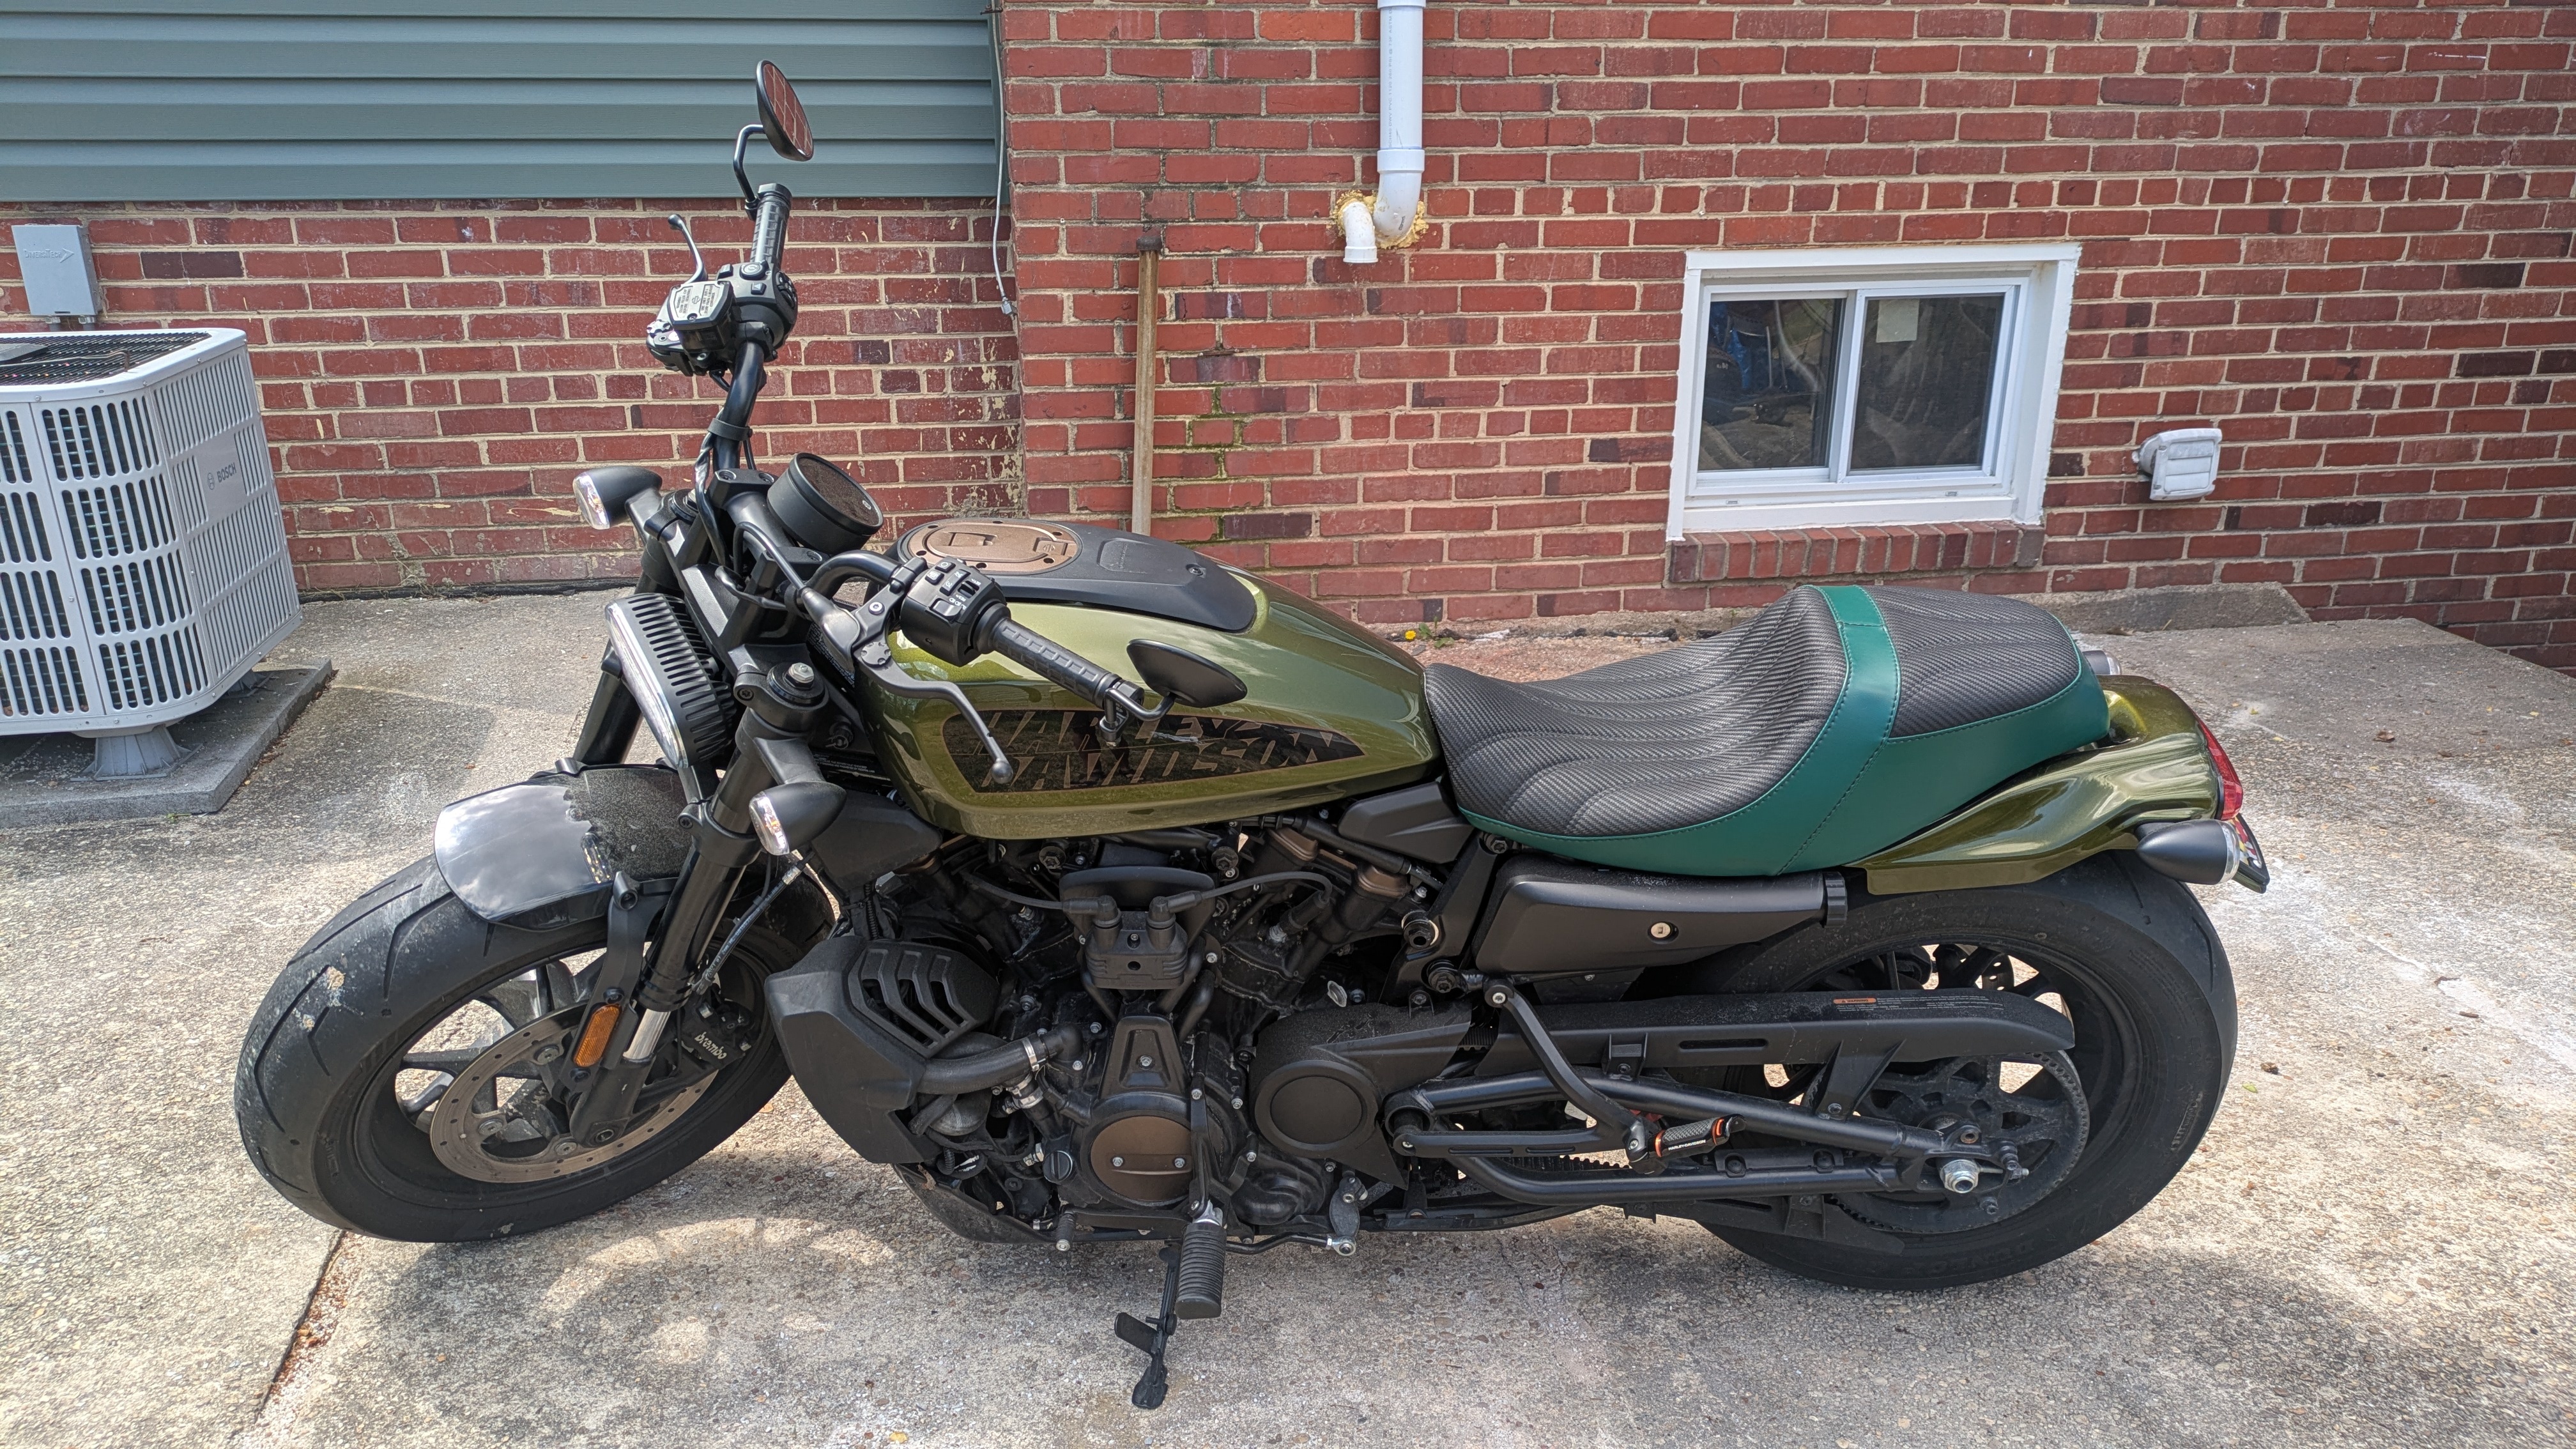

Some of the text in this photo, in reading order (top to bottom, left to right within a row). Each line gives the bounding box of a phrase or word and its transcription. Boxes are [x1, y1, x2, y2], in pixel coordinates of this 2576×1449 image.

[217, 462, 237, 483] BOSCH
[694, 1032, 727, 1059] brembo
[1668, 1139, 1706, 1151] HARLEY-DAVIDSON
